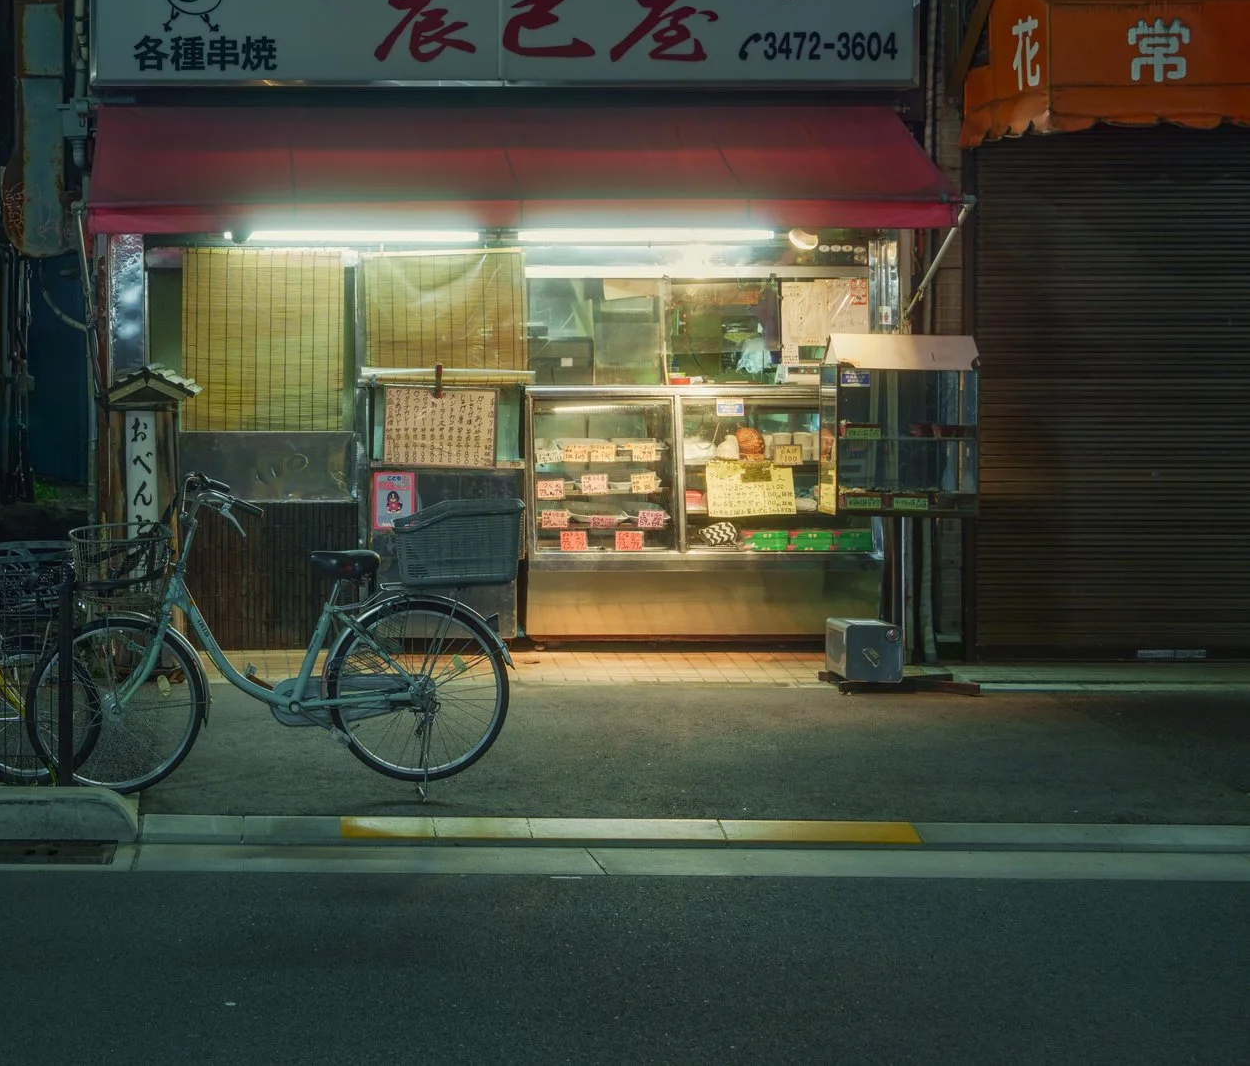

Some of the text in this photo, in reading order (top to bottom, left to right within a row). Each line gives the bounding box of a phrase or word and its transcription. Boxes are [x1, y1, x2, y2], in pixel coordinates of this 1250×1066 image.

[134, 35, 278, 72] 各種串焼
[763, 31, 898, 61] 3472-3604
[1012, 16, 1040, 91] 花
[1127, 17, 1190, 83] 常
[131, 417, 155, 566] おべんと
